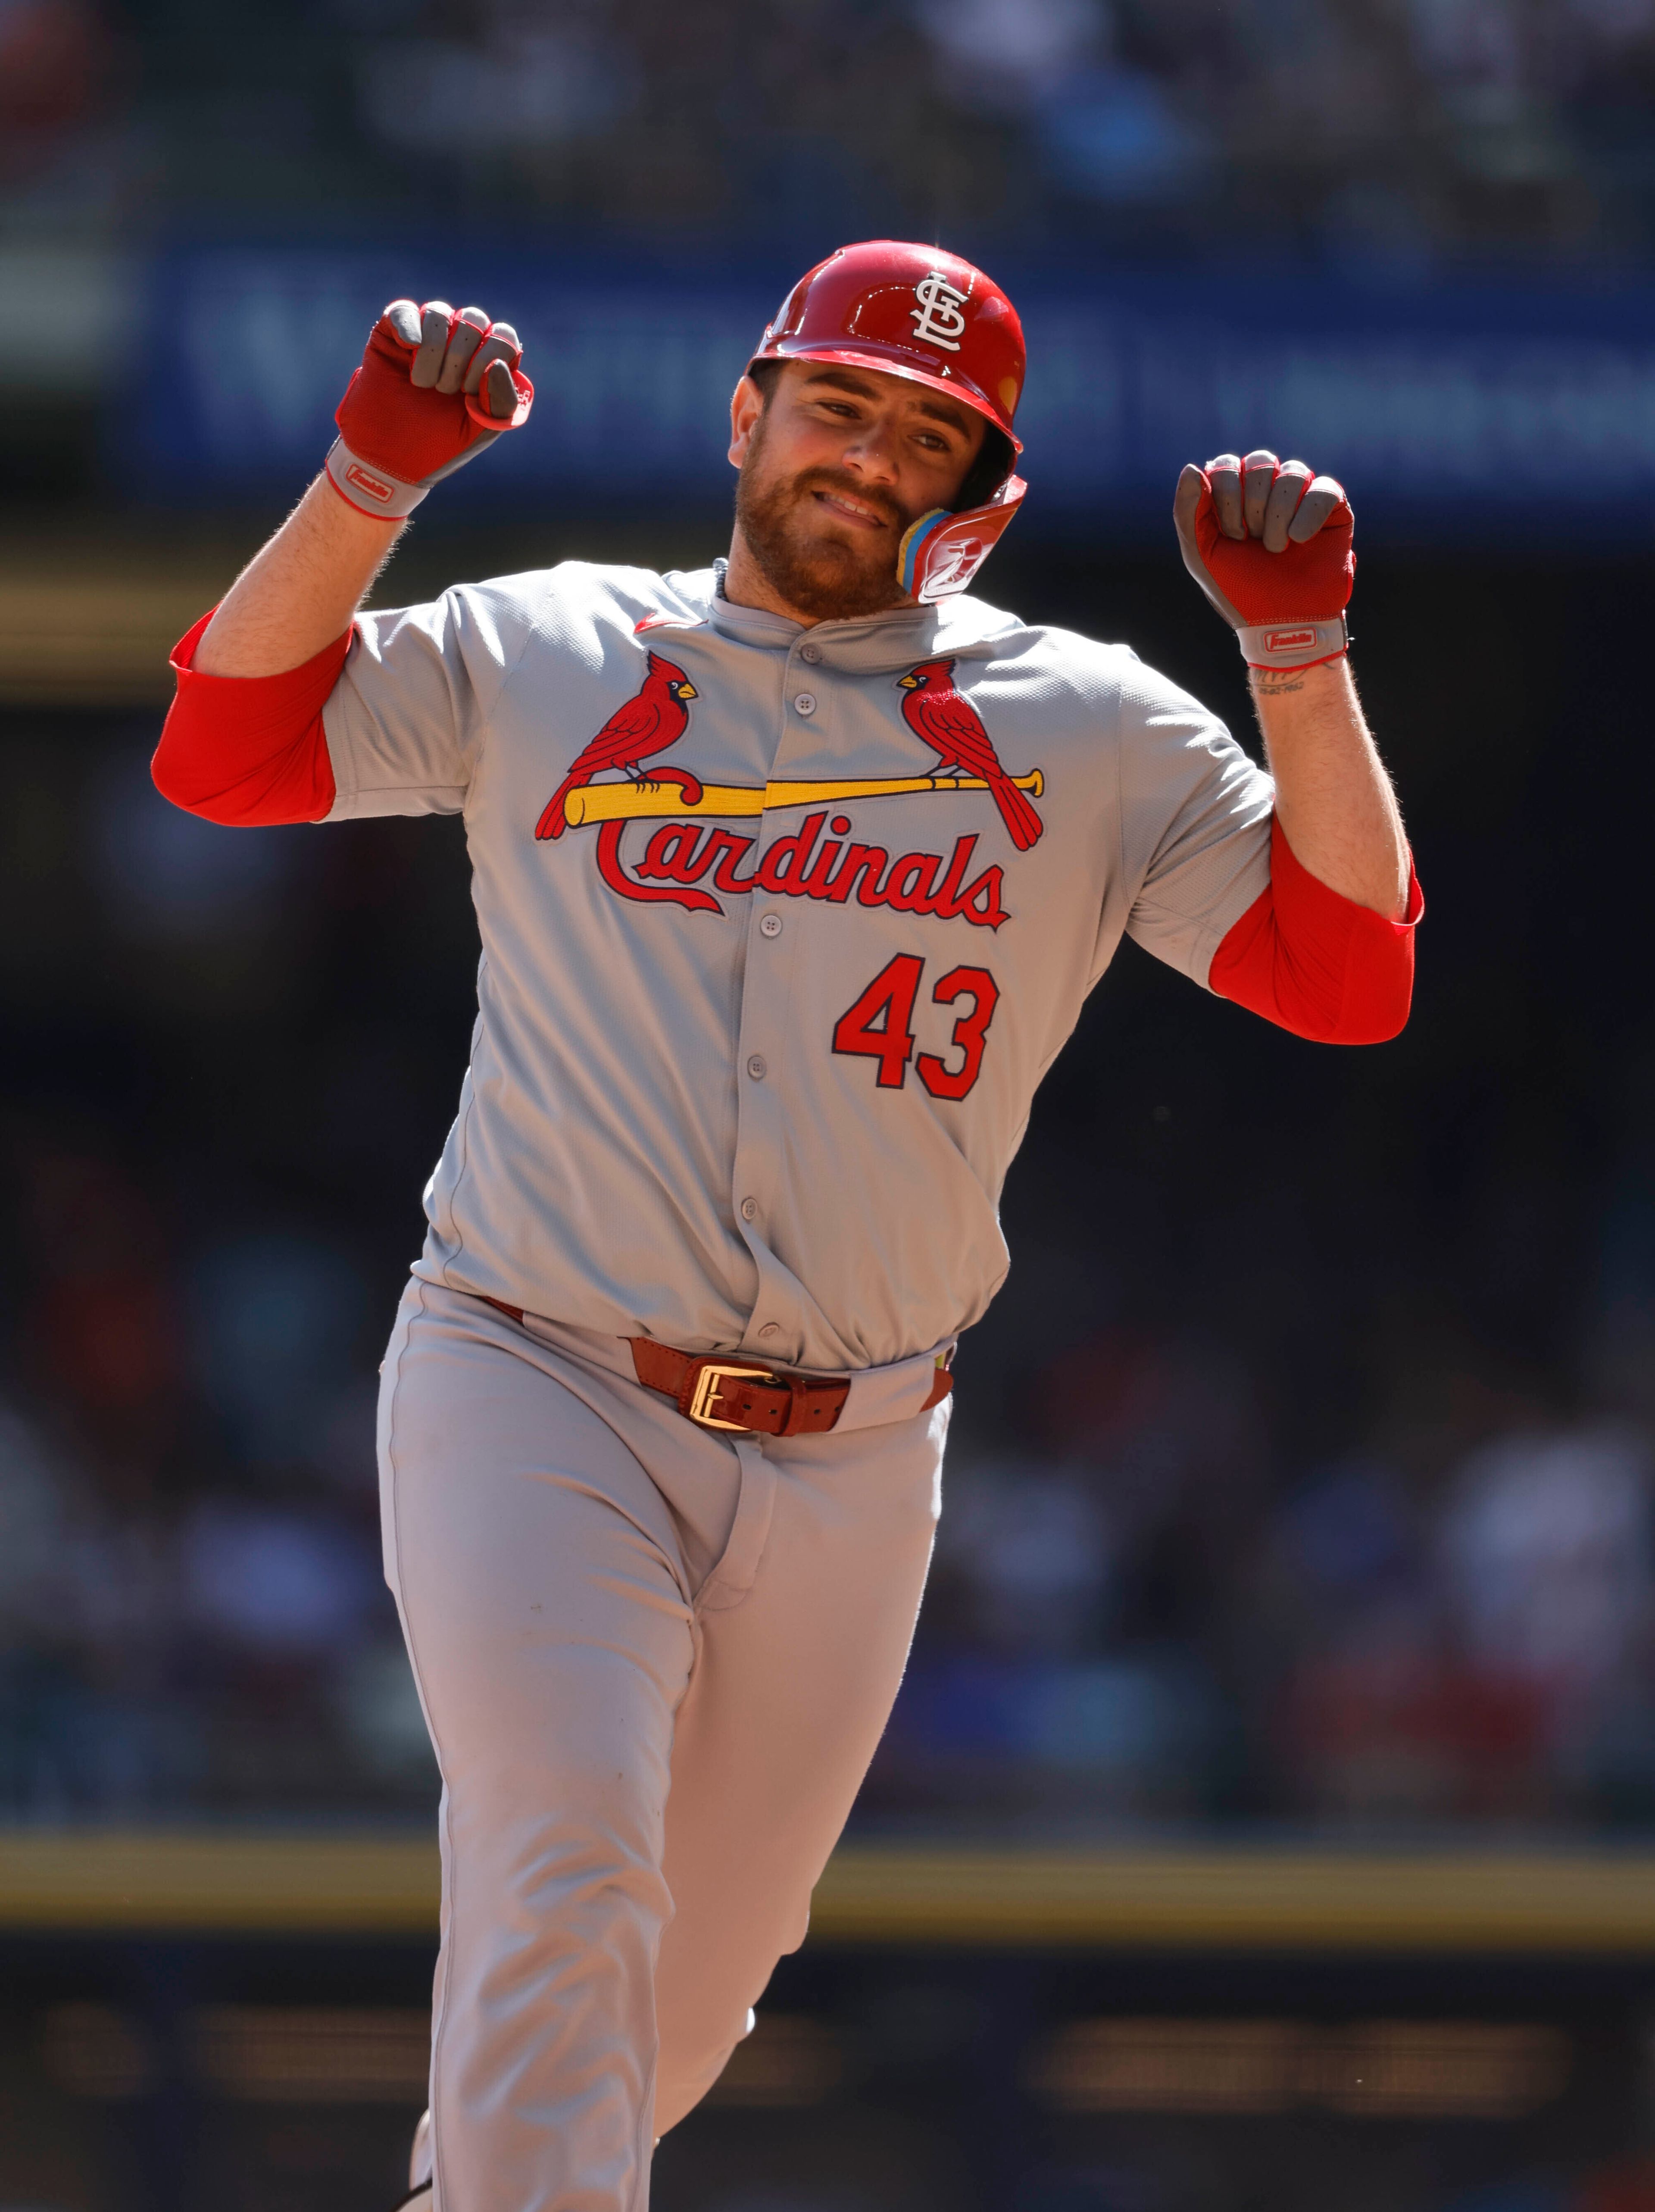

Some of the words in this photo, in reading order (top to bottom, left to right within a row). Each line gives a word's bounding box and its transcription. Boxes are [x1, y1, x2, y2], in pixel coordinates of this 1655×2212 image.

[1270, 633, 1312, 650] Franklin
[596, 766, 1012, 933] Cardinals
[831, 952, 1000, 1102] 43
